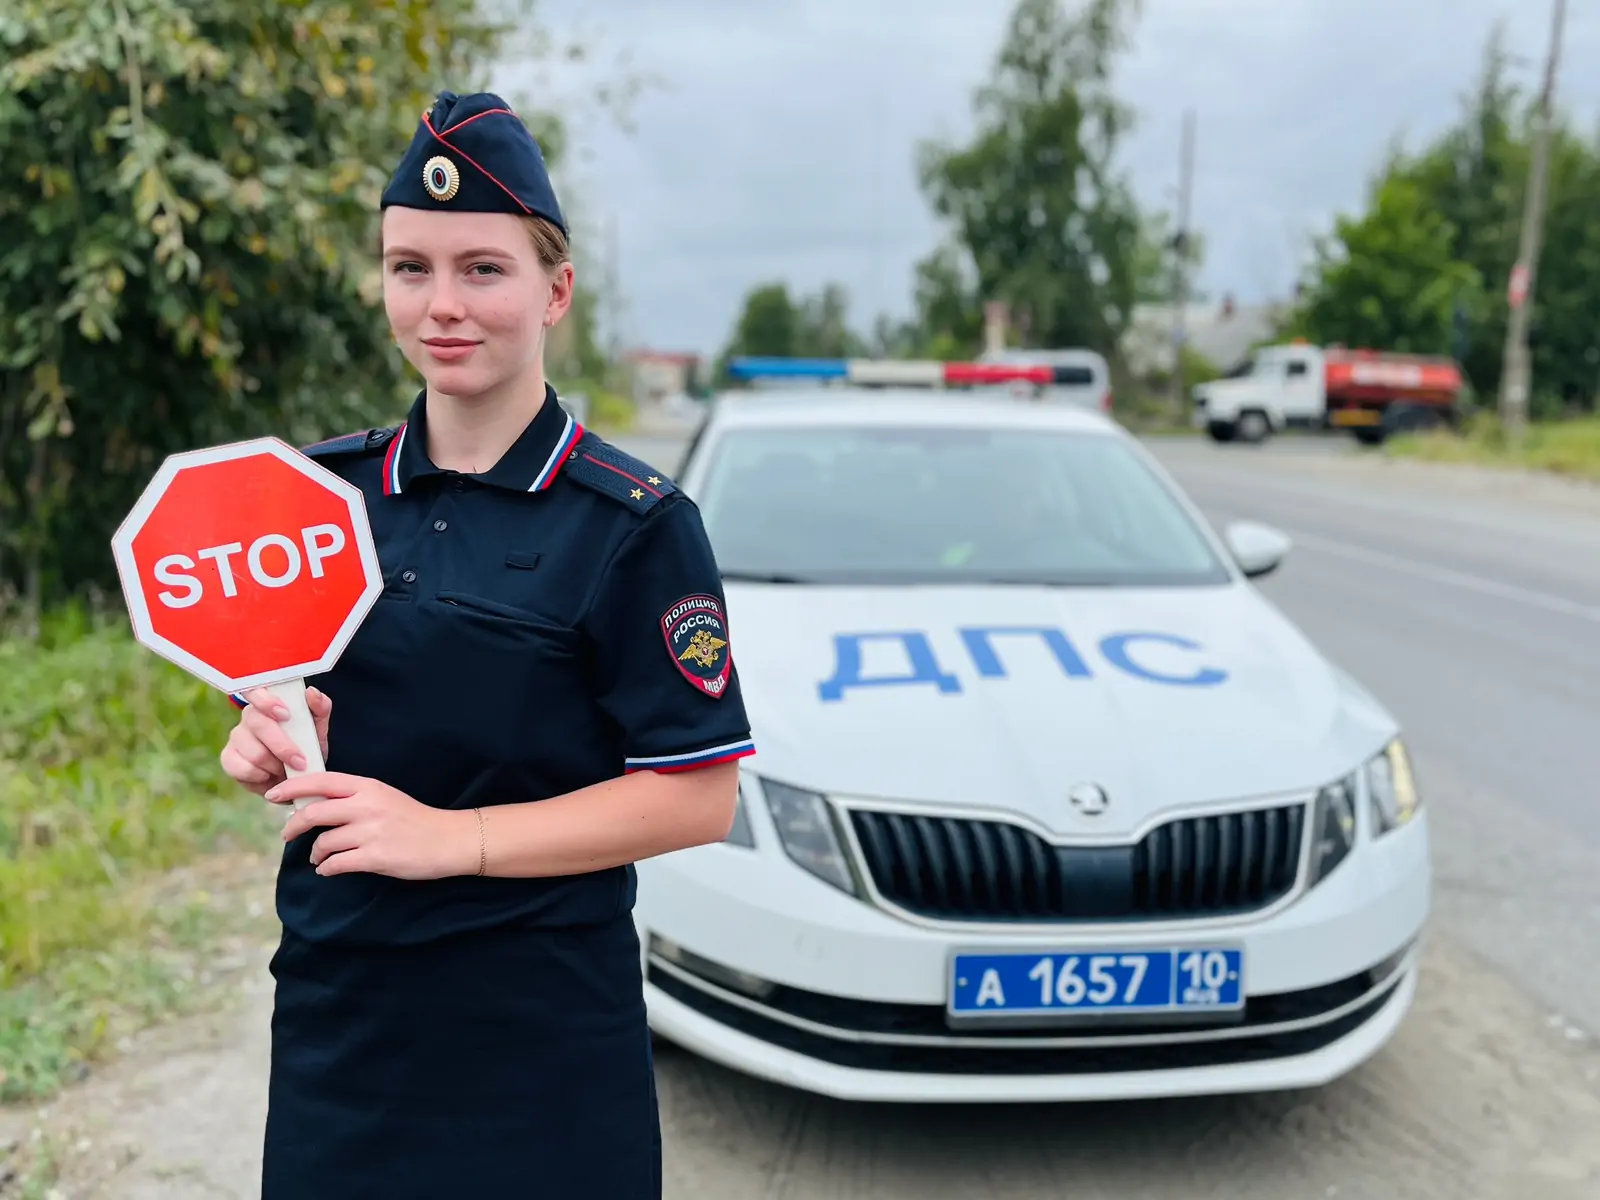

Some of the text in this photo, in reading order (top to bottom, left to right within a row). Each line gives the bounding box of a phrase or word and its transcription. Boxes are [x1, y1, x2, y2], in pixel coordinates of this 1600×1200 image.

[154, 523, 345, 608] STOP
[665, 599, 718, 628] ПОЛИЦИЯ
[673, 615, 720, 643] РОССИЯ
[703, 675, 725, 693] МВД
[817, 626, 1229, 701] ДПС
[976, 969, 1006, 1007] А
[1029, 955, 1149, 1006] 1657
[1181, 952, 1228, 989] 10
